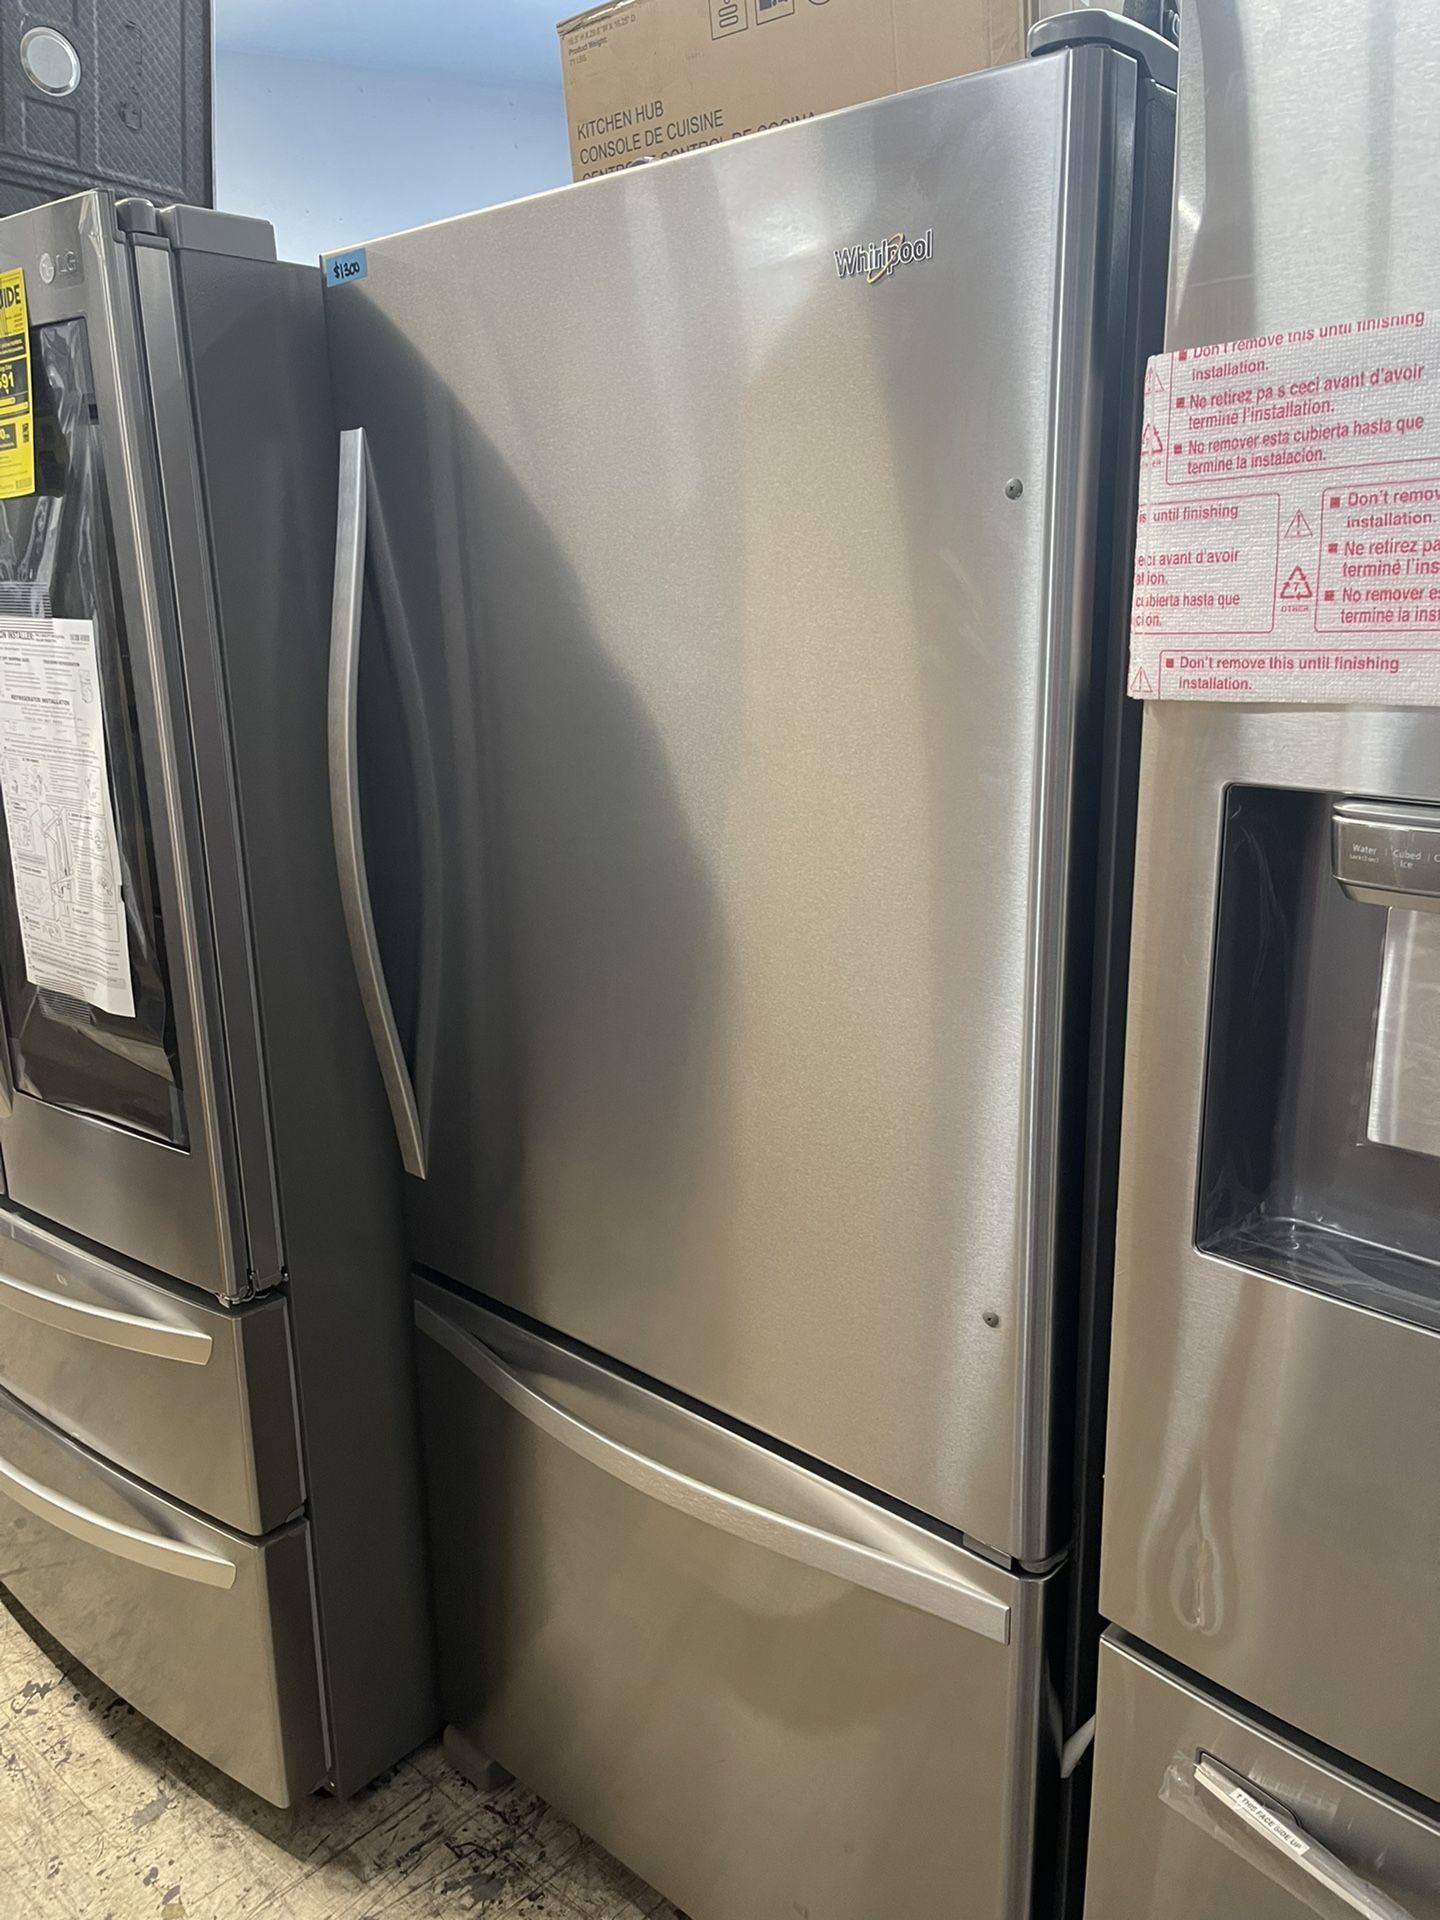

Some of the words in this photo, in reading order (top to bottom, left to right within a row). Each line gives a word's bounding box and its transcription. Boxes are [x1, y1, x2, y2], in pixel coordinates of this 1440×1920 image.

[577, 109, 633, 141] KITCHEN
[635, 99, 665, 124] HUB
[580, 130, 642, 165] CONSOLE
[644, 127, 664, 146] DE
[666, 108, 725, 140] CUISINE
[56, 250, 77, 273] LG
[833, 228, 934, 277] Whirlpool
[333, 260, 361, 279] $1300
[1232, 332, 1284, 352] remove
[1191, 359, 1269, 381] installation.
[1189, 395, 1207, 410] Ne
[1210, 389, 1251, 407] retirez
[1290, 376, 1319, 395] ceci
[1324, 371, 1365, 391] avant
[1370, 363, 1424, 386] d'avoir
[1242, 399, 1335, 423] l'installation.
[1188, 440, 1204, 455] No
[1208, 435, 1260, 453] remover
[1262, 429, 1290, 446] esta
[1293, 421, 1349, 442] cubierta
[1353, 418, 1392, 436] hasta
[1396, 415, 1424, 433] que
[1187, 457, 1233, 475] termine
[1236, 455, 1247, 469] la
[1348, 489, 1388, 507] Don't
[1153, 507, 1180, 522] until
[1183, 503, 1239, 519] finishing
[1346, 511, 1437, 528] installation.
[1159, 551, 1192, 566] avant
[1195, 546, 1241, 564] d'avoir
[1344, 540, 1365, 556] Ne
[1369, 537, 1418, 555] retirez
[1342, 558, 1401, 577] terminé
[1182, 592, 1214, 607] hasta
[1217, 593, 1241, 609] que
[1342, 587, 1361, 603] No
[1365, 587, 1424, 602] remover
[1398, 606, 1410, 622] la
[1179, 655, 1214, 670] Don't
[1217, 657, 1266, 670] remove
[1269, 655, 1295, 670] this
[1300, 655, 1330, 670] until
[1335, 655, 1399, 673] finishing
[1179, 676, 1253, 691] installation.
[1352, 843, 1377, 855] Water
[1392, 849, 1422, 860] Cubed
[1400, 859, 1413, 869] Ice
[1242, 1797, 1259, 1812] THIS
[1255, 1808, 1275, 1827] FACE
[1273, 1825, 1291, 1841] SIDE
[1289, 1838, 1303, 1849] UP
